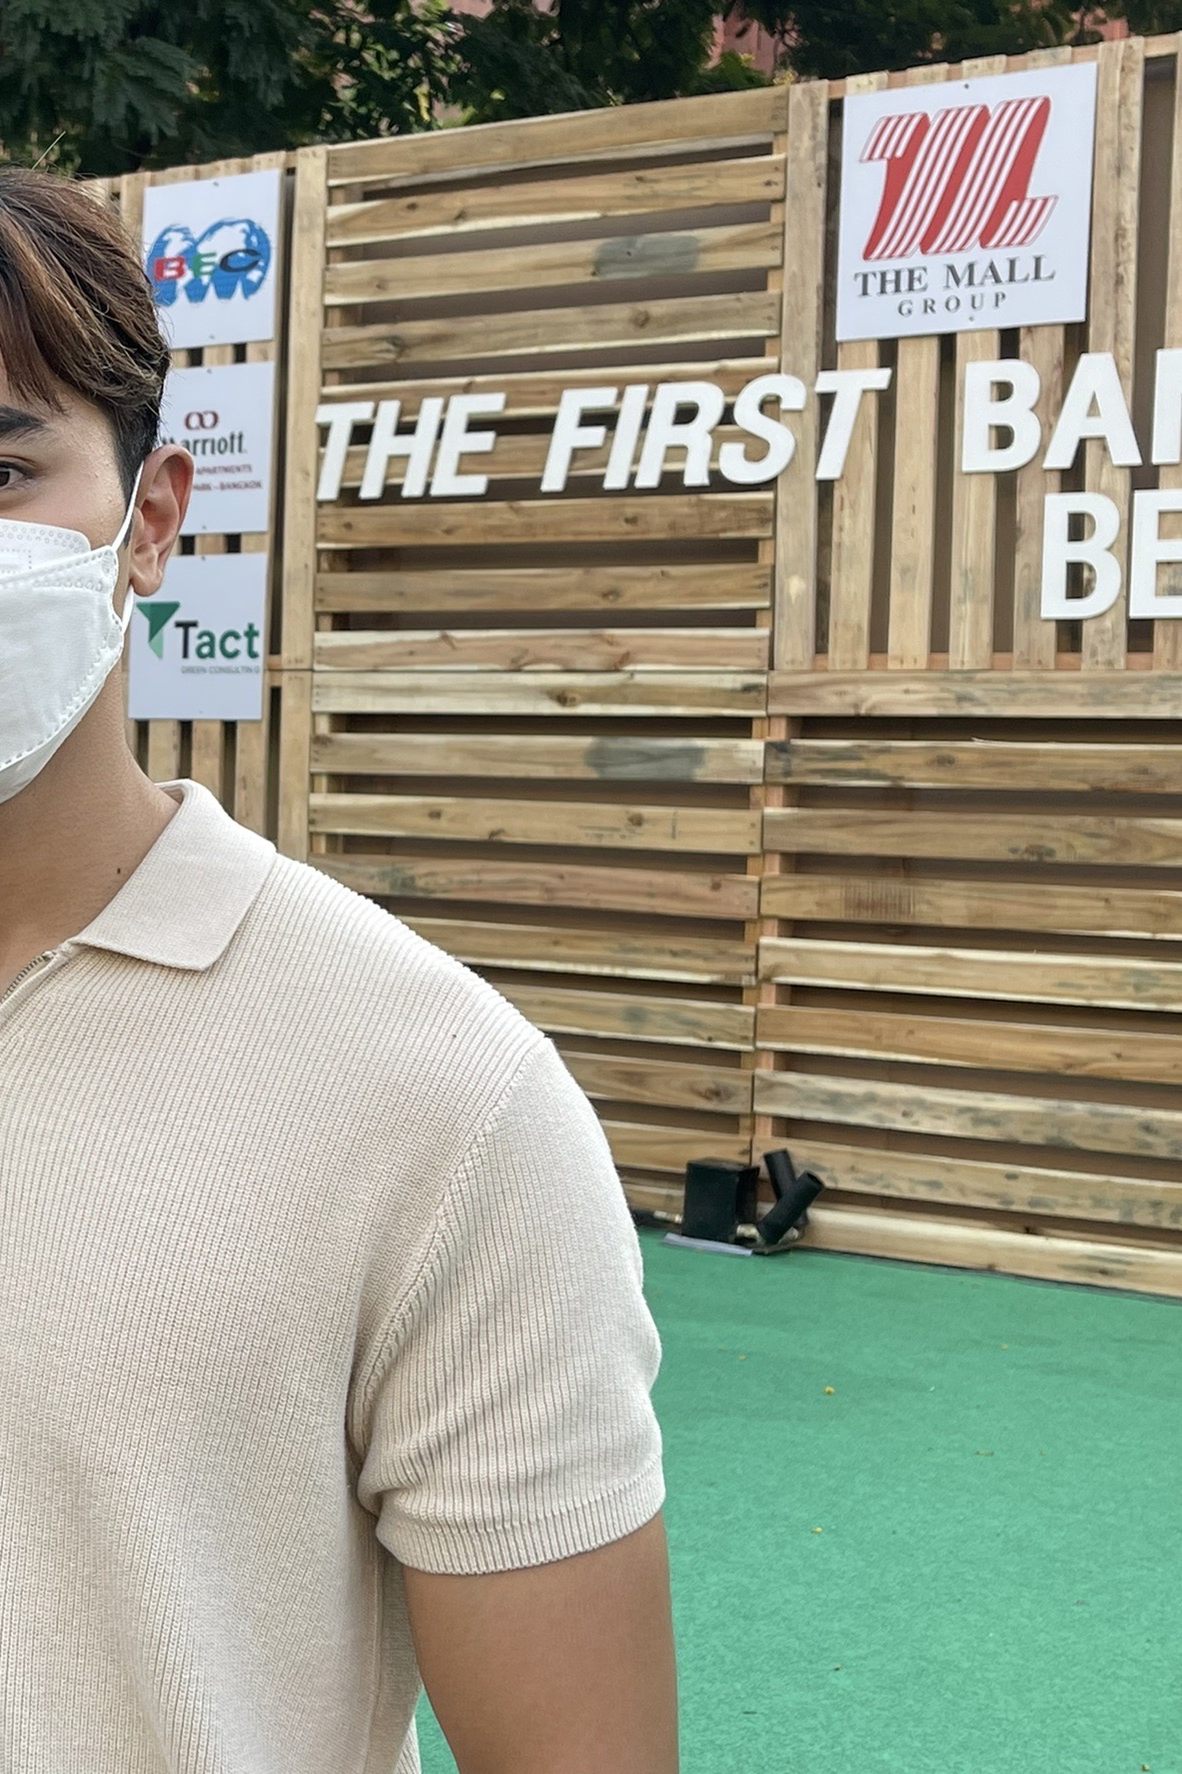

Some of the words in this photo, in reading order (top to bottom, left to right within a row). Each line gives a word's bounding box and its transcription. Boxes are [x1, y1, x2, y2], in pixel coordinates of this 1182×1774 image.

[154, 248, 261, 281] BEC
[854, 266, 929, 299] THE
[943, 254, 1056, 289] MALL
[898, 291, 1007, 317] GROUP
[314, 392, 506, 501] THE
[540, 367, 893, 493] FIRST
[961, 347, 1182, 474] BA
[196, 463, 253, 475] APARTMENTS
[1040, 487, 1182, 621] BE
[175, 620, 260, 660] Tact
